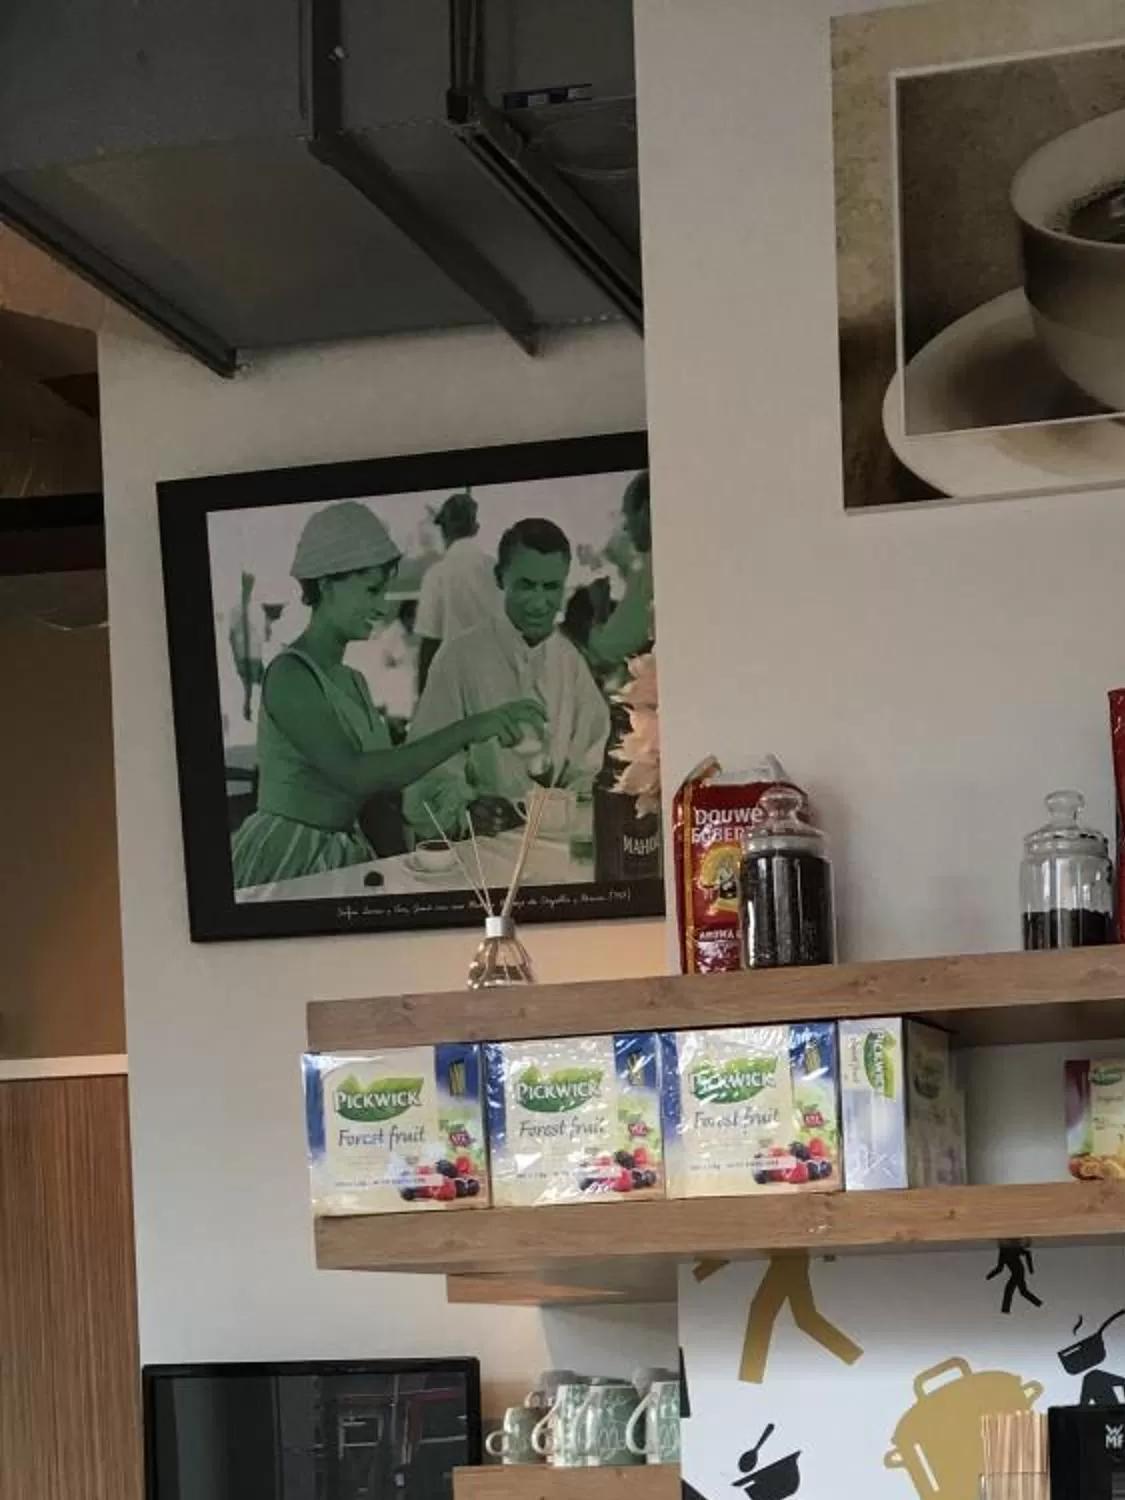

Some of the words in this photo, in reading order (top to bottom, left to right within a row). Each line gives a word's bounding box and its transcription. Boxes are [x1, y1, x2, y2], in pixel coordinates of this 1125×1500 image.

[517, 1081, 602, 1102] PICKWICK
[691, 1072, 775, 1094] PCKWICK
[336, 1090, 424, 1112] PICKWICK
[338, 1128, 384, 1147] Forest
[389, 1124, 425, 1150] fruit
[519, 1119, 565, 1138] Forest
